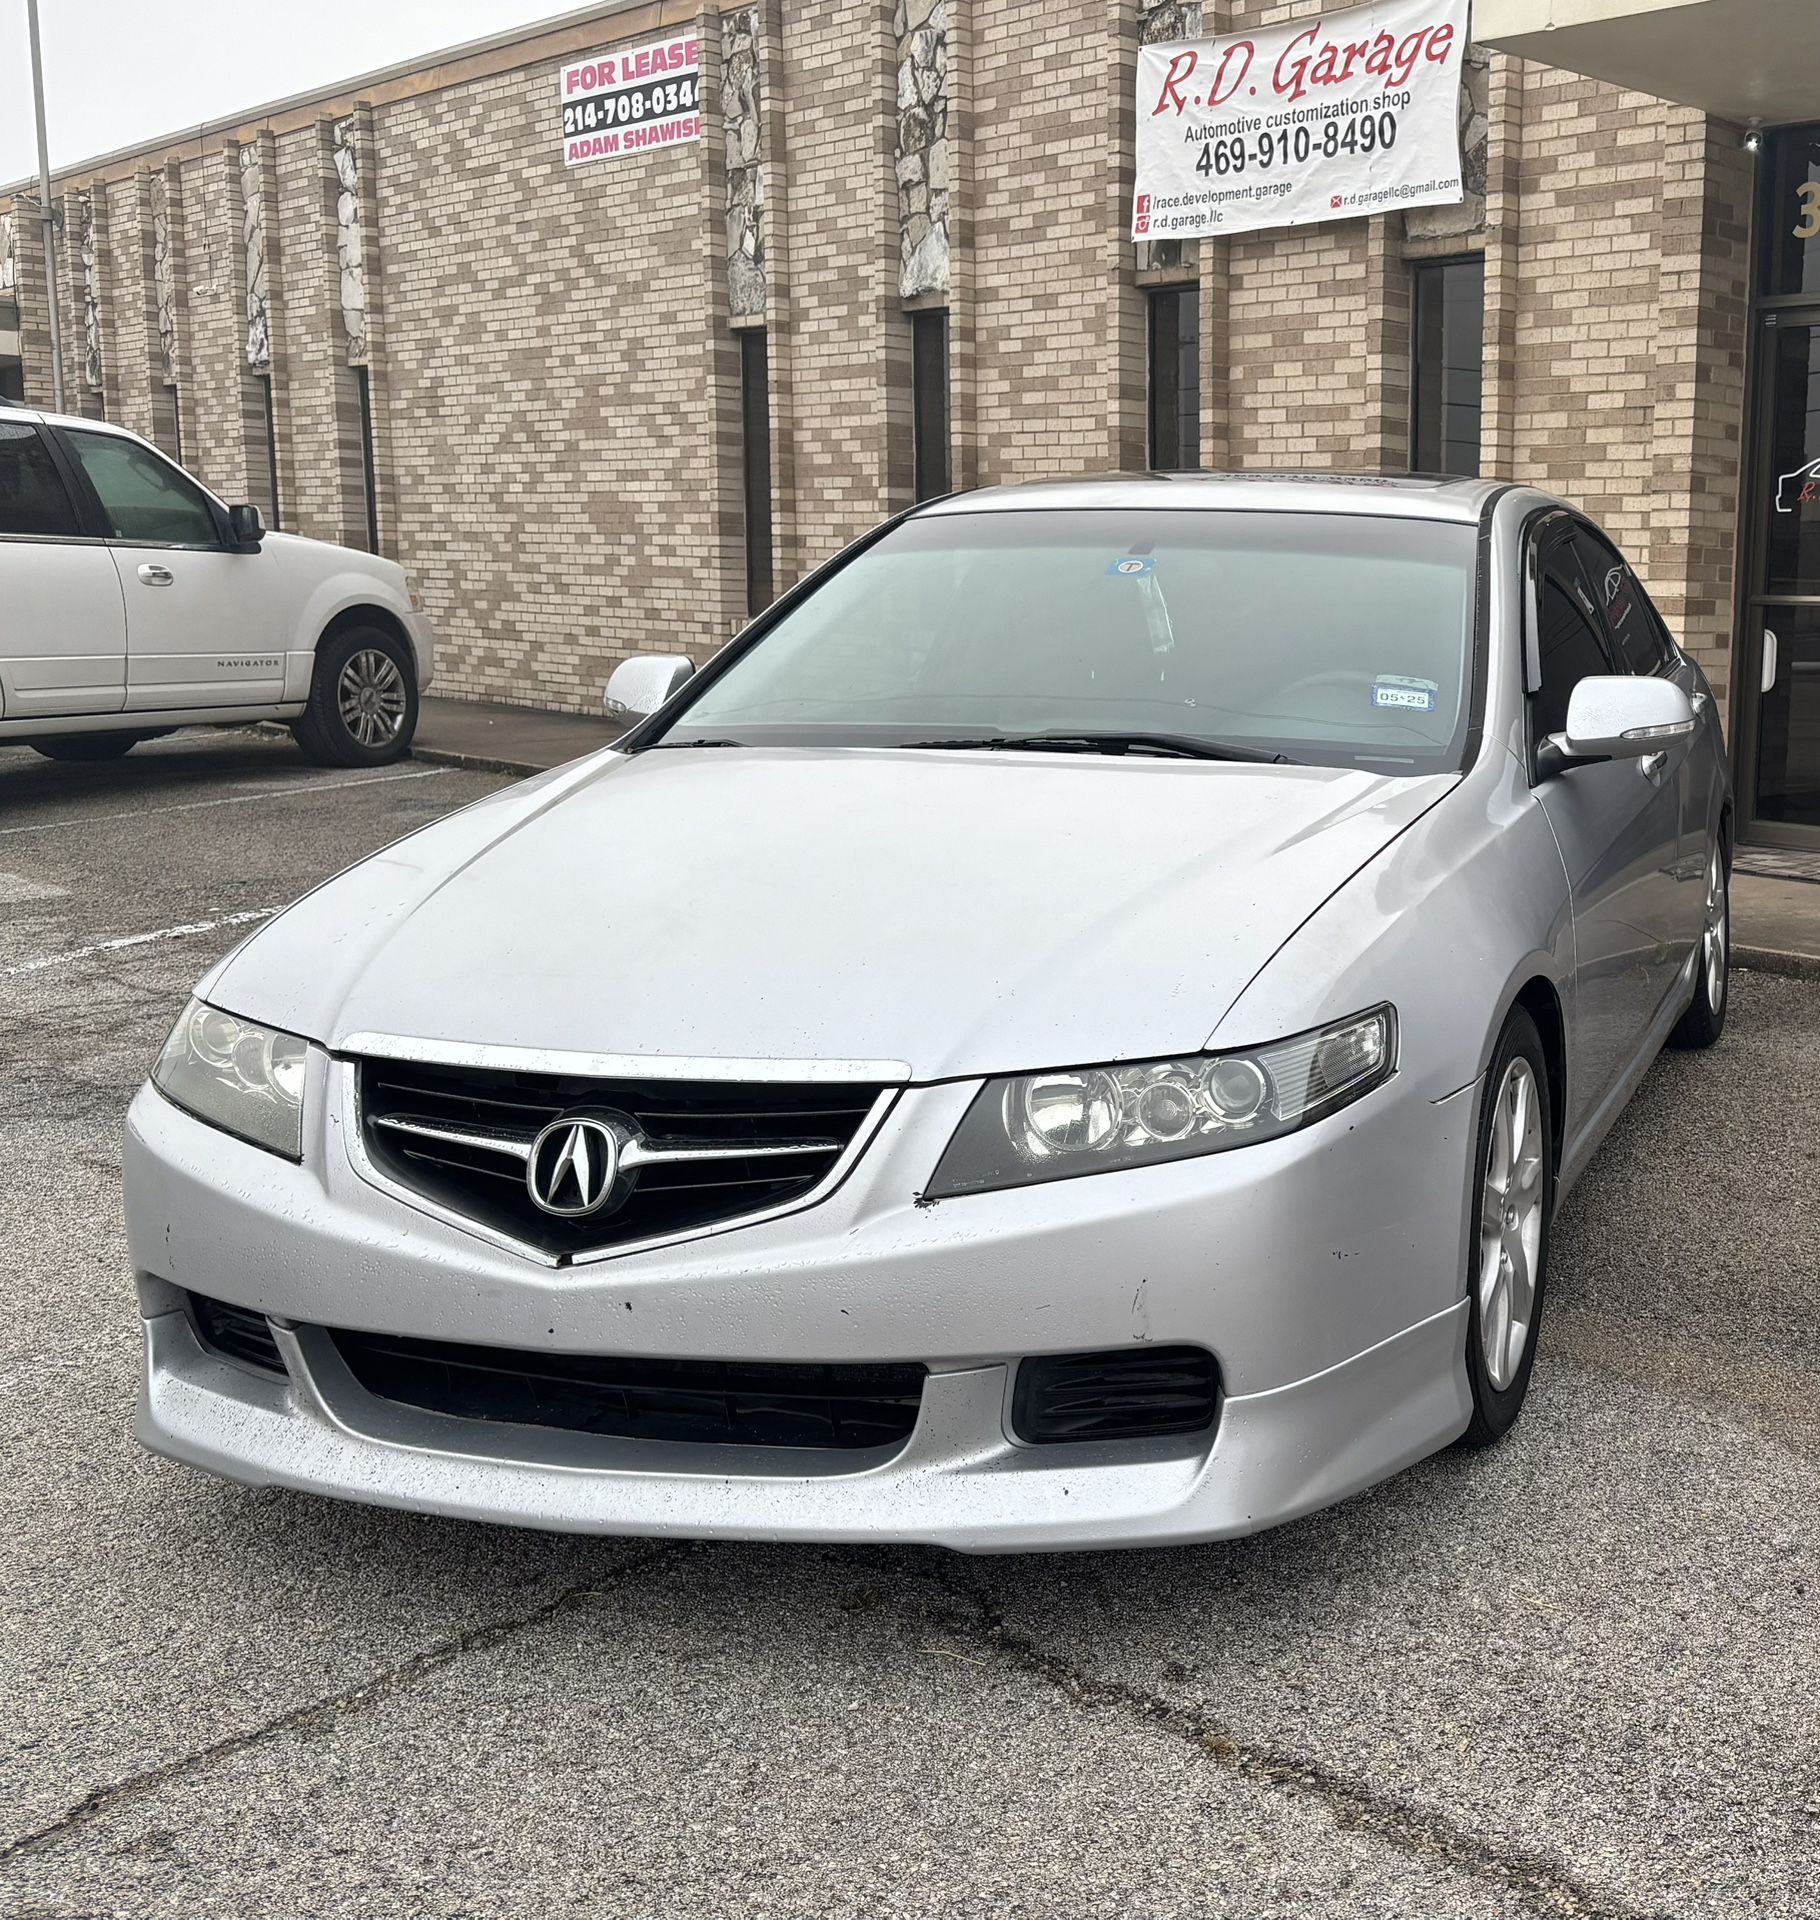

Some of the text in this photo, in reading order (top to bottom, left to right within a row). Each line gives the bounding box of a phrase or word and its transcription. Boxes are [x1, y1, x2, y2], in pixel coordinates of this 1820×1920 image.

[566, 39, 699, 95] FOR LEASE
[1151, 21, 1455, 117] R.D. Garage
[1184, 89, 1411, 143] Automotive customization shop
[568, 134, 619, 161] ADAM
[1196, 111, 1397, 177] 469-910-8490
[1152, 182, 1293, 210] /race.development.garage
[1343, 178, 1459, 206] r.d.garagellc@gmail.com
[1792, 181, 1820, 239] 3
[1152, 210, 1223, 231] r.d.garage.llc
[217, 659, 279, 668] NAVIGATOR
